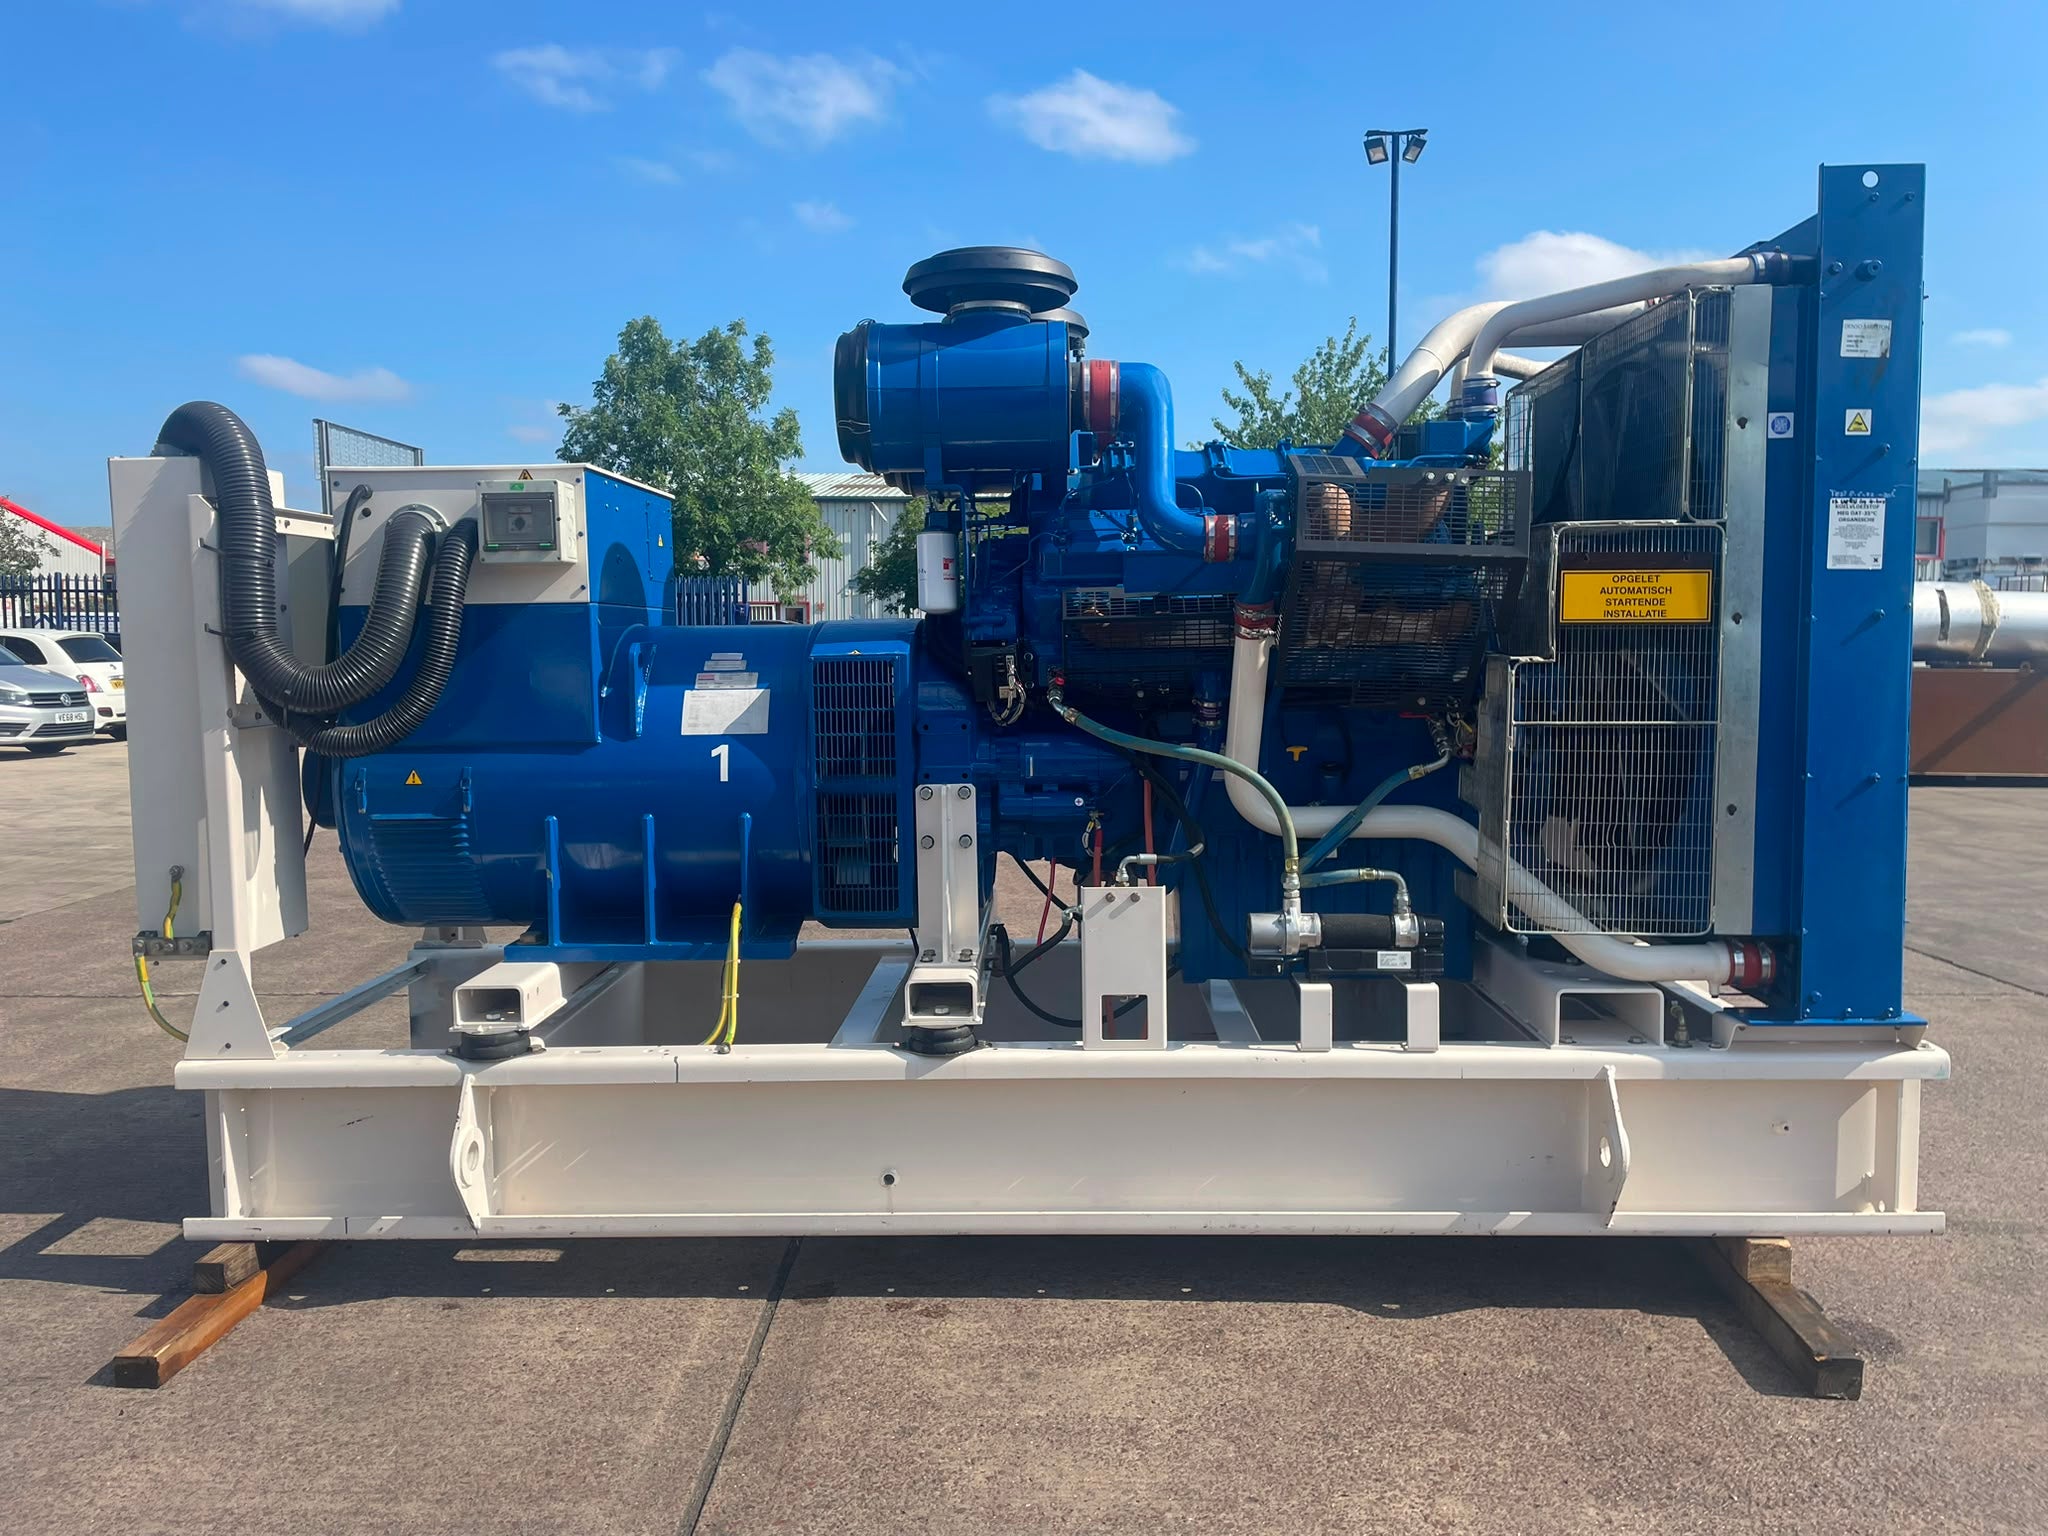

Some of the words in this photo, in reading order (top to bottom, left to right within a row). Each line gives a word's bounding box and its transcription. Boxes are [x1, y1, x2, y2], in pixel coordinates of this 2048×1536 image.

[1612, 575, 1660, 583] OPGELET
[1600, 586, 1672, 594] AUTOMATISCH
[1605, 598, 1666, 606] STARTENDE
[1603, 609, 1667, 618] INSTALLATIE
[711, 744, 729, 782] 1
